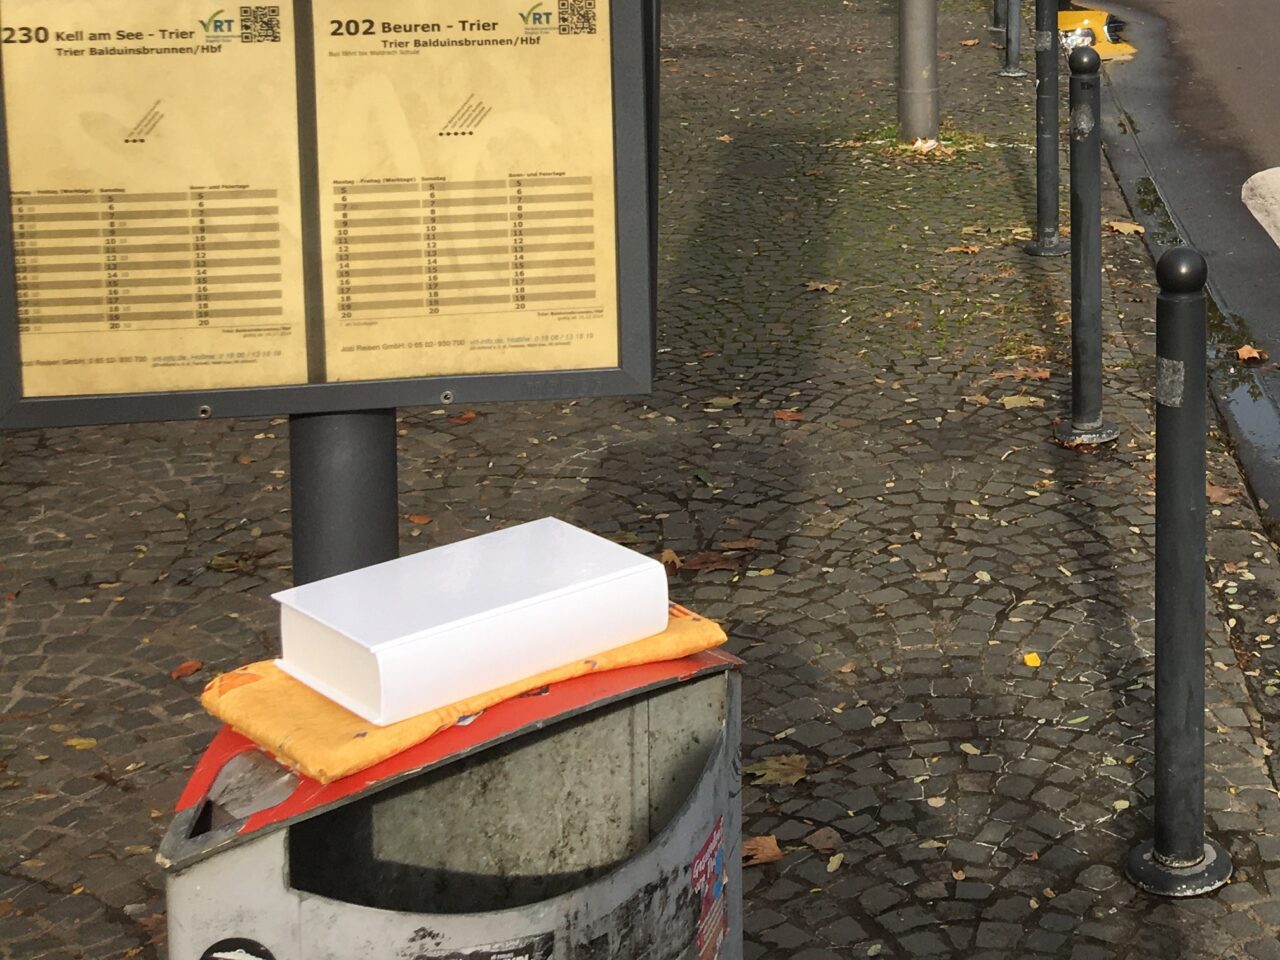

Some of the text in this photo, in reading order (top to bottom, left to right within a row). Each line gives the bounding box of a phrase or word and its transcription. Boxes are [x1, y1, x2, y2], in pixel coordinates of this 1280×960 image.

[2, 26, 49, 44] 230
[55, 31, 84, 41] Kell
[88, 32, 111, 41] am
[116, 30, 144, 40] See
[158, 29, 196, 40] Trier
[198, 9, 235, 33] VRT
[330, 19, 376, 36] 202
[381, 22, 441, 33] Beuren
[458, 20, 499, 32] Trier
[518, 2, 553, 25] VRT
[55, 44, 222, 56] Trier Balduinsbrunnen/Hbf
[381, 36, 541, 48] Trier Balduinsbrunnen/Hbf
